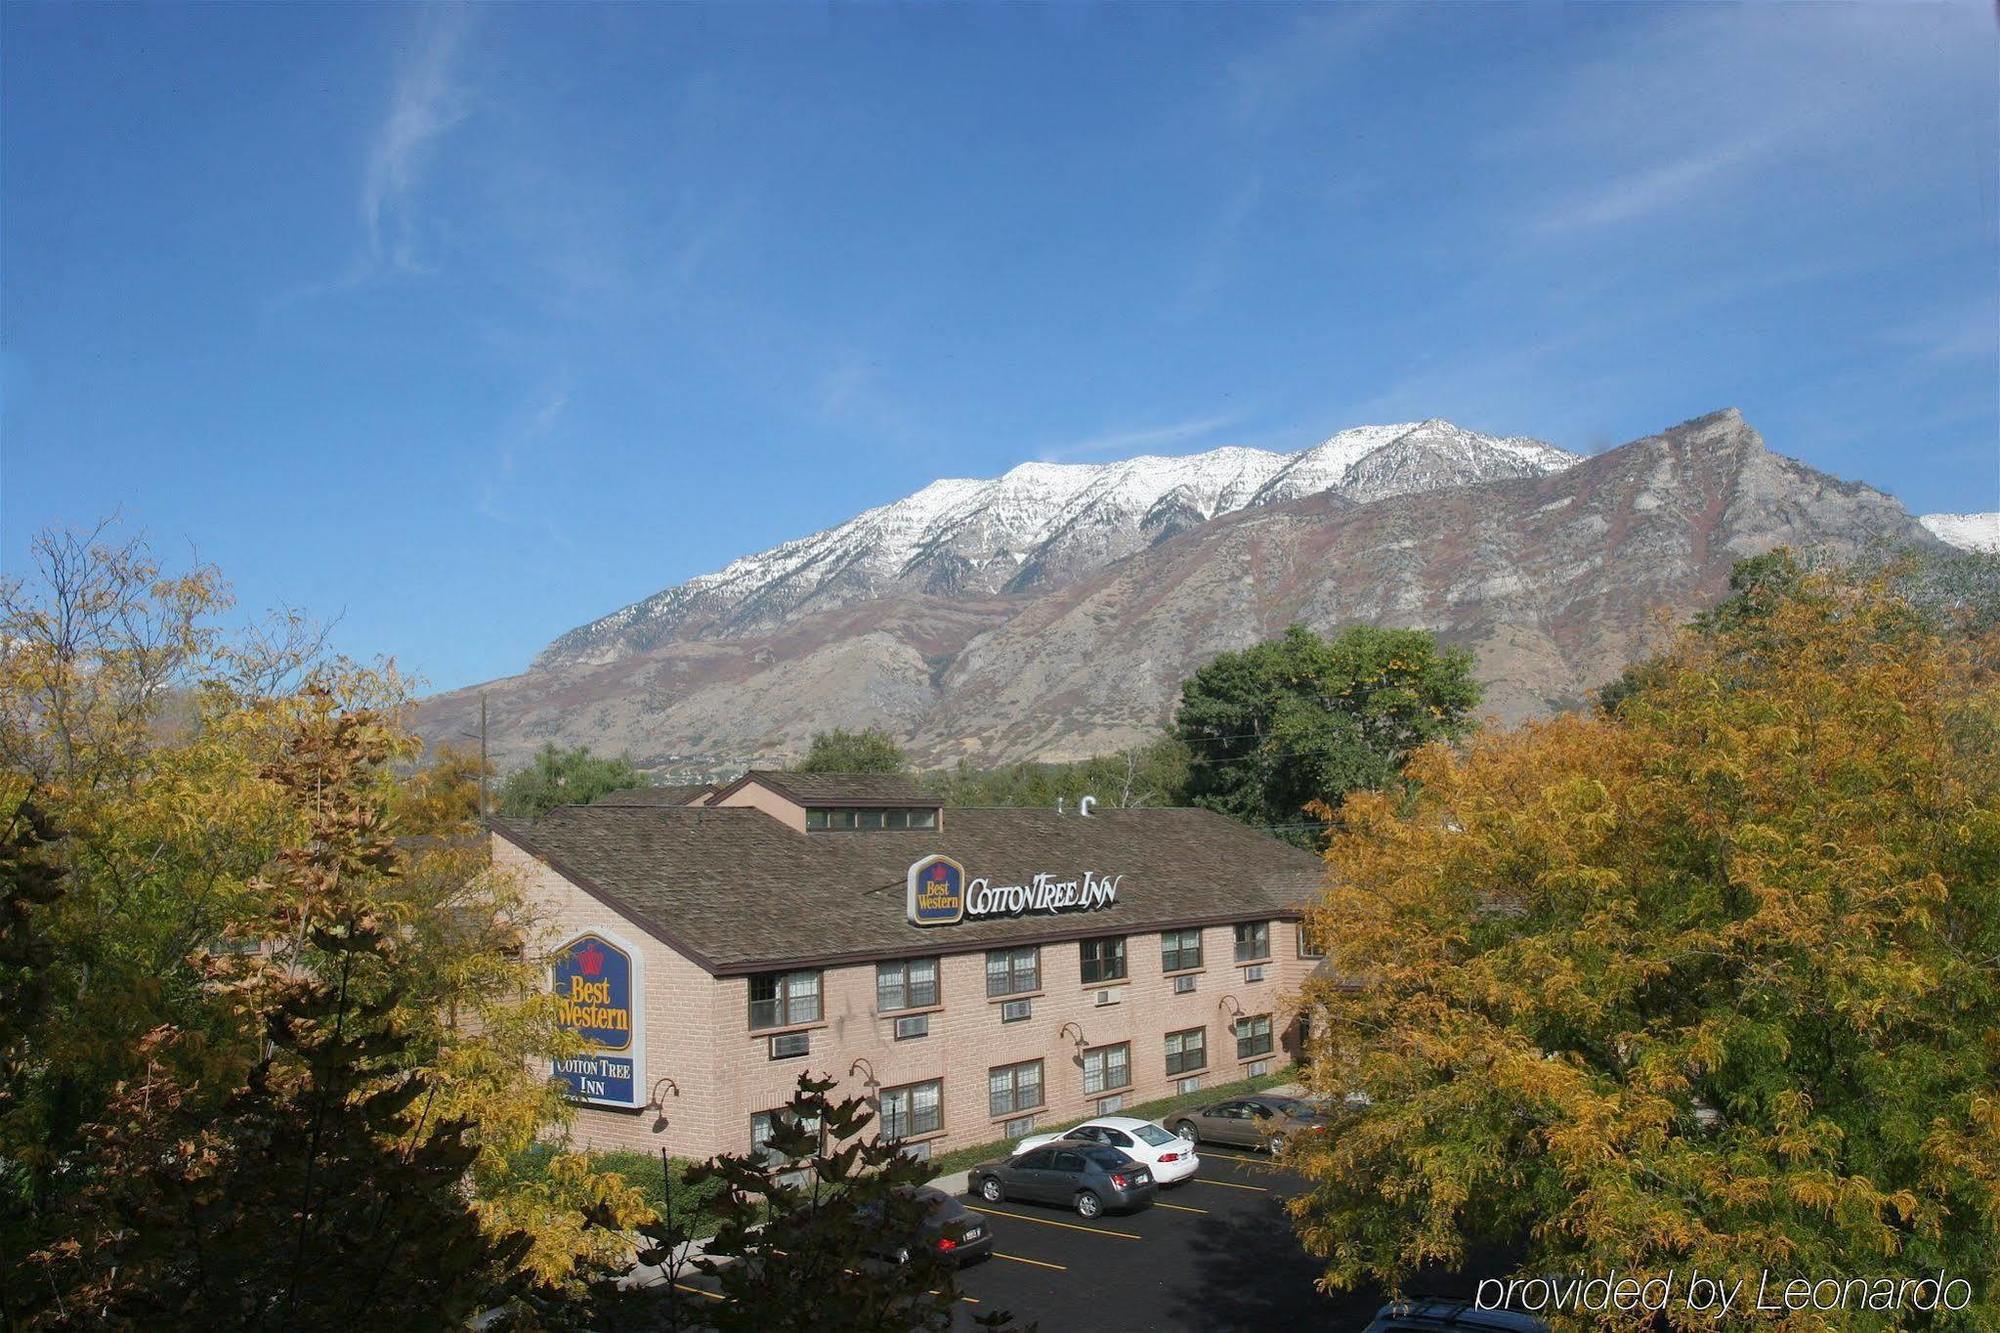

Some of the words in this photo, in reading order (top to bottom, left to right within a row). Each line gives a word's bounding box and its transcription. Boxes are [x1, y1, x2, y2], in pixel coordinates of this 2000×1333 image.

[927, 880, 949, 896] Best
[1078, 871, 1123, 909] INN
[918, 894, 959, 909] Western
[571, 975, 611, 1004] Best
[559, 1000, 628, 1030] Western
[600, 1059, 631, 1079] TREE
[580, 1076, 605, 1096] INN
